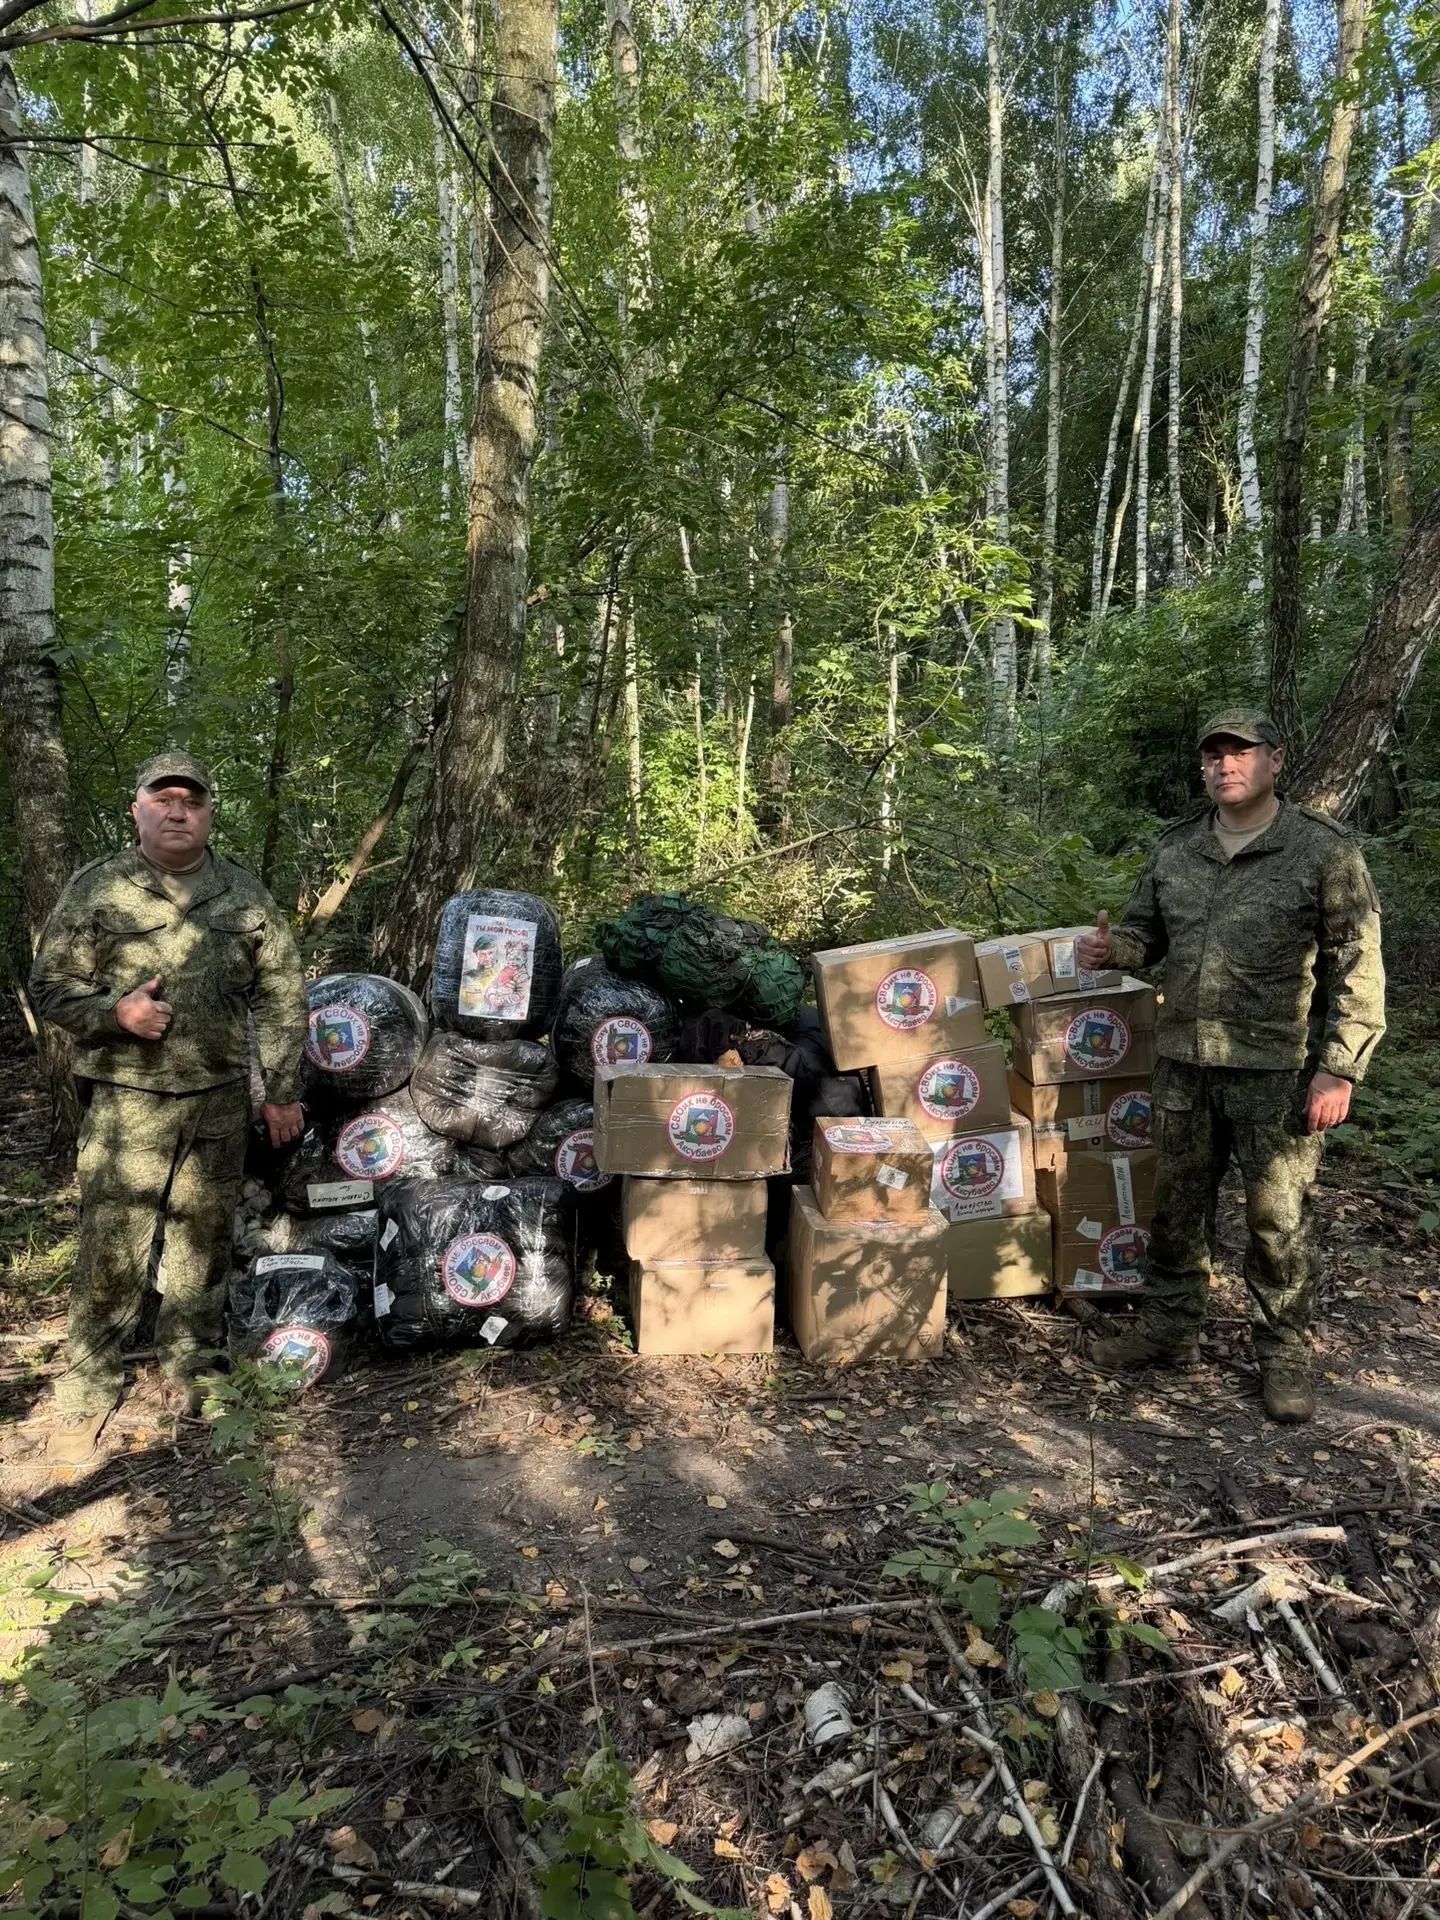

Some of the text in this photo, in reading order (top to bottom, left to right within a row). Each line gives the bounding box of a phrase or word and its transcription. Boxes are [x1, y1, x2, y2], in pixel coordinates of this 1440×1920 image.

[671, 1099, 694, 1130] СВОих
[710, 1097, 732, 1136] бросаем
[676, 1140, 723, 1158] Аксубаево
